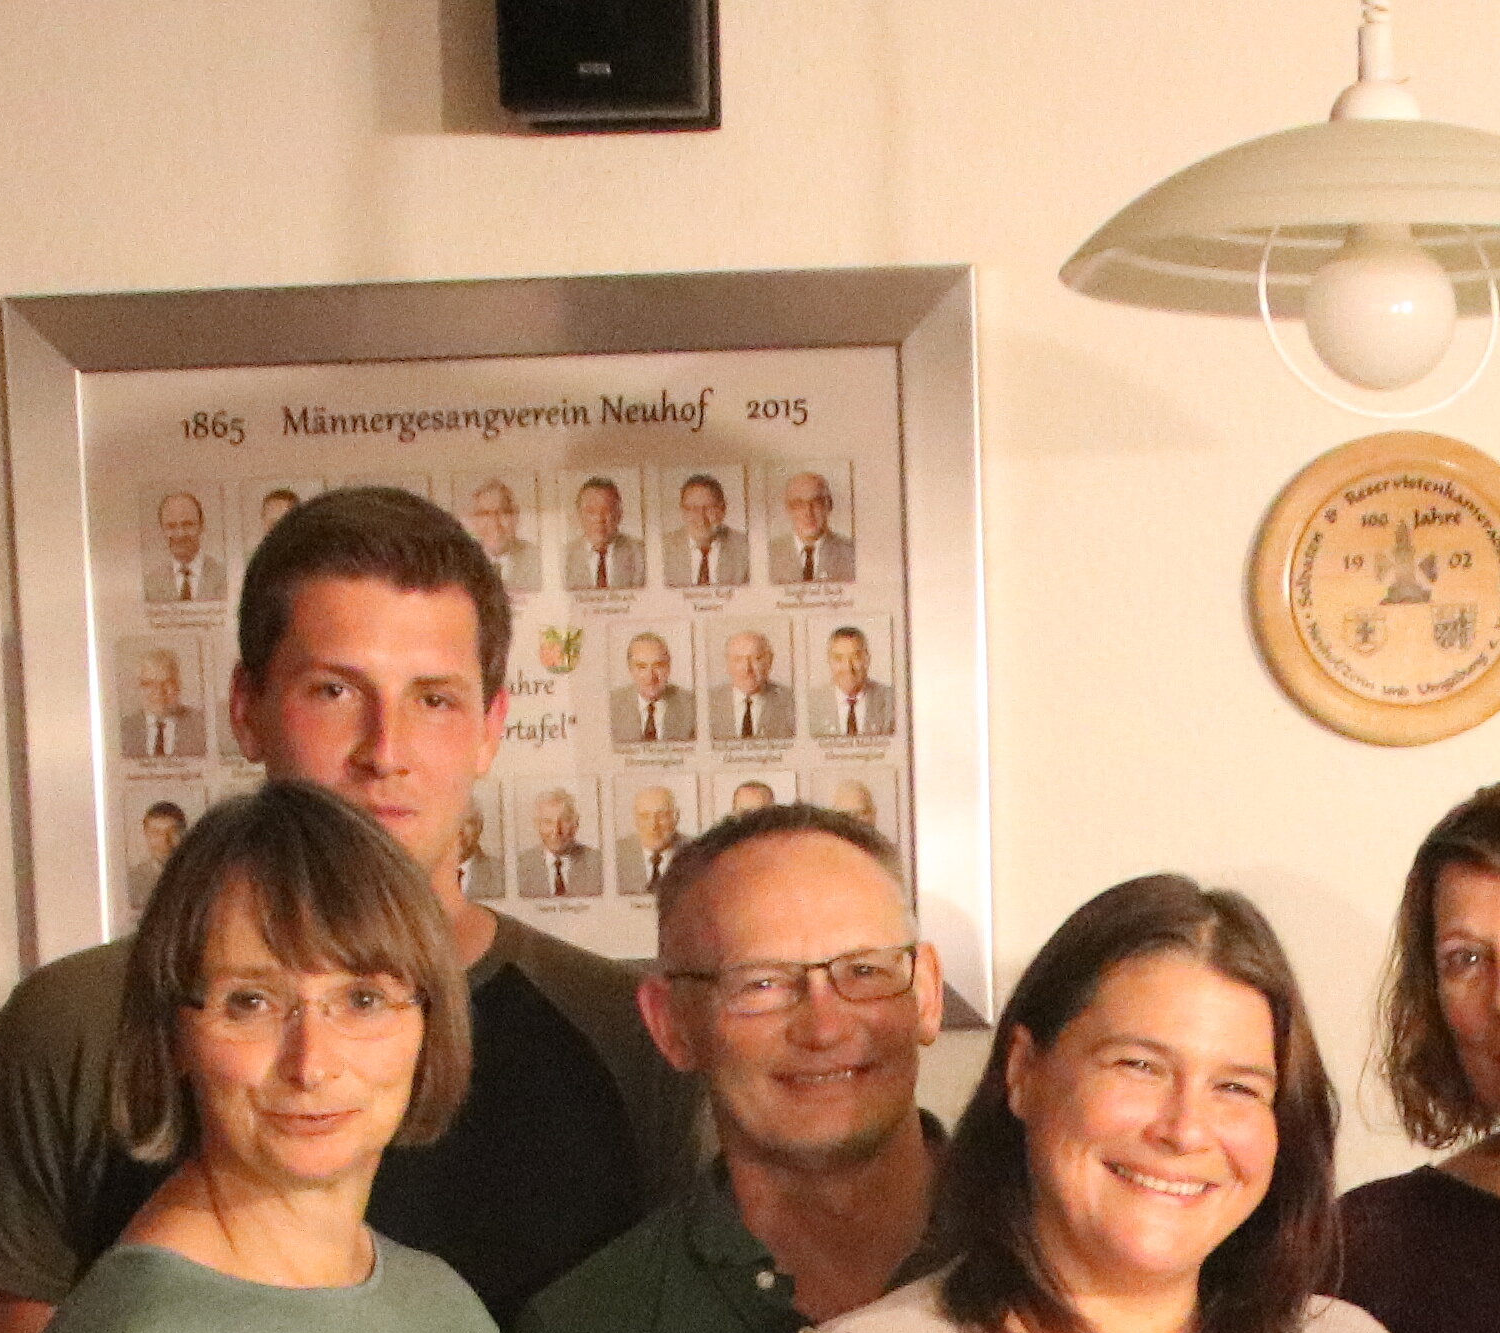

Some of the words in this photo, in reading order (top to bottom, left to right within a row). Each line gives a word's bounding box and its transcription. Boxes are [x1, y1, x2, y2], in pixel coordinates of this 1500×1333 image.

[180, 409, 246, 446] 1865
[282, 400, 591, 443] Männergesangverein
[601, 387, 714, 432] Neuhof
[747, 398, 809, 426] 2015
